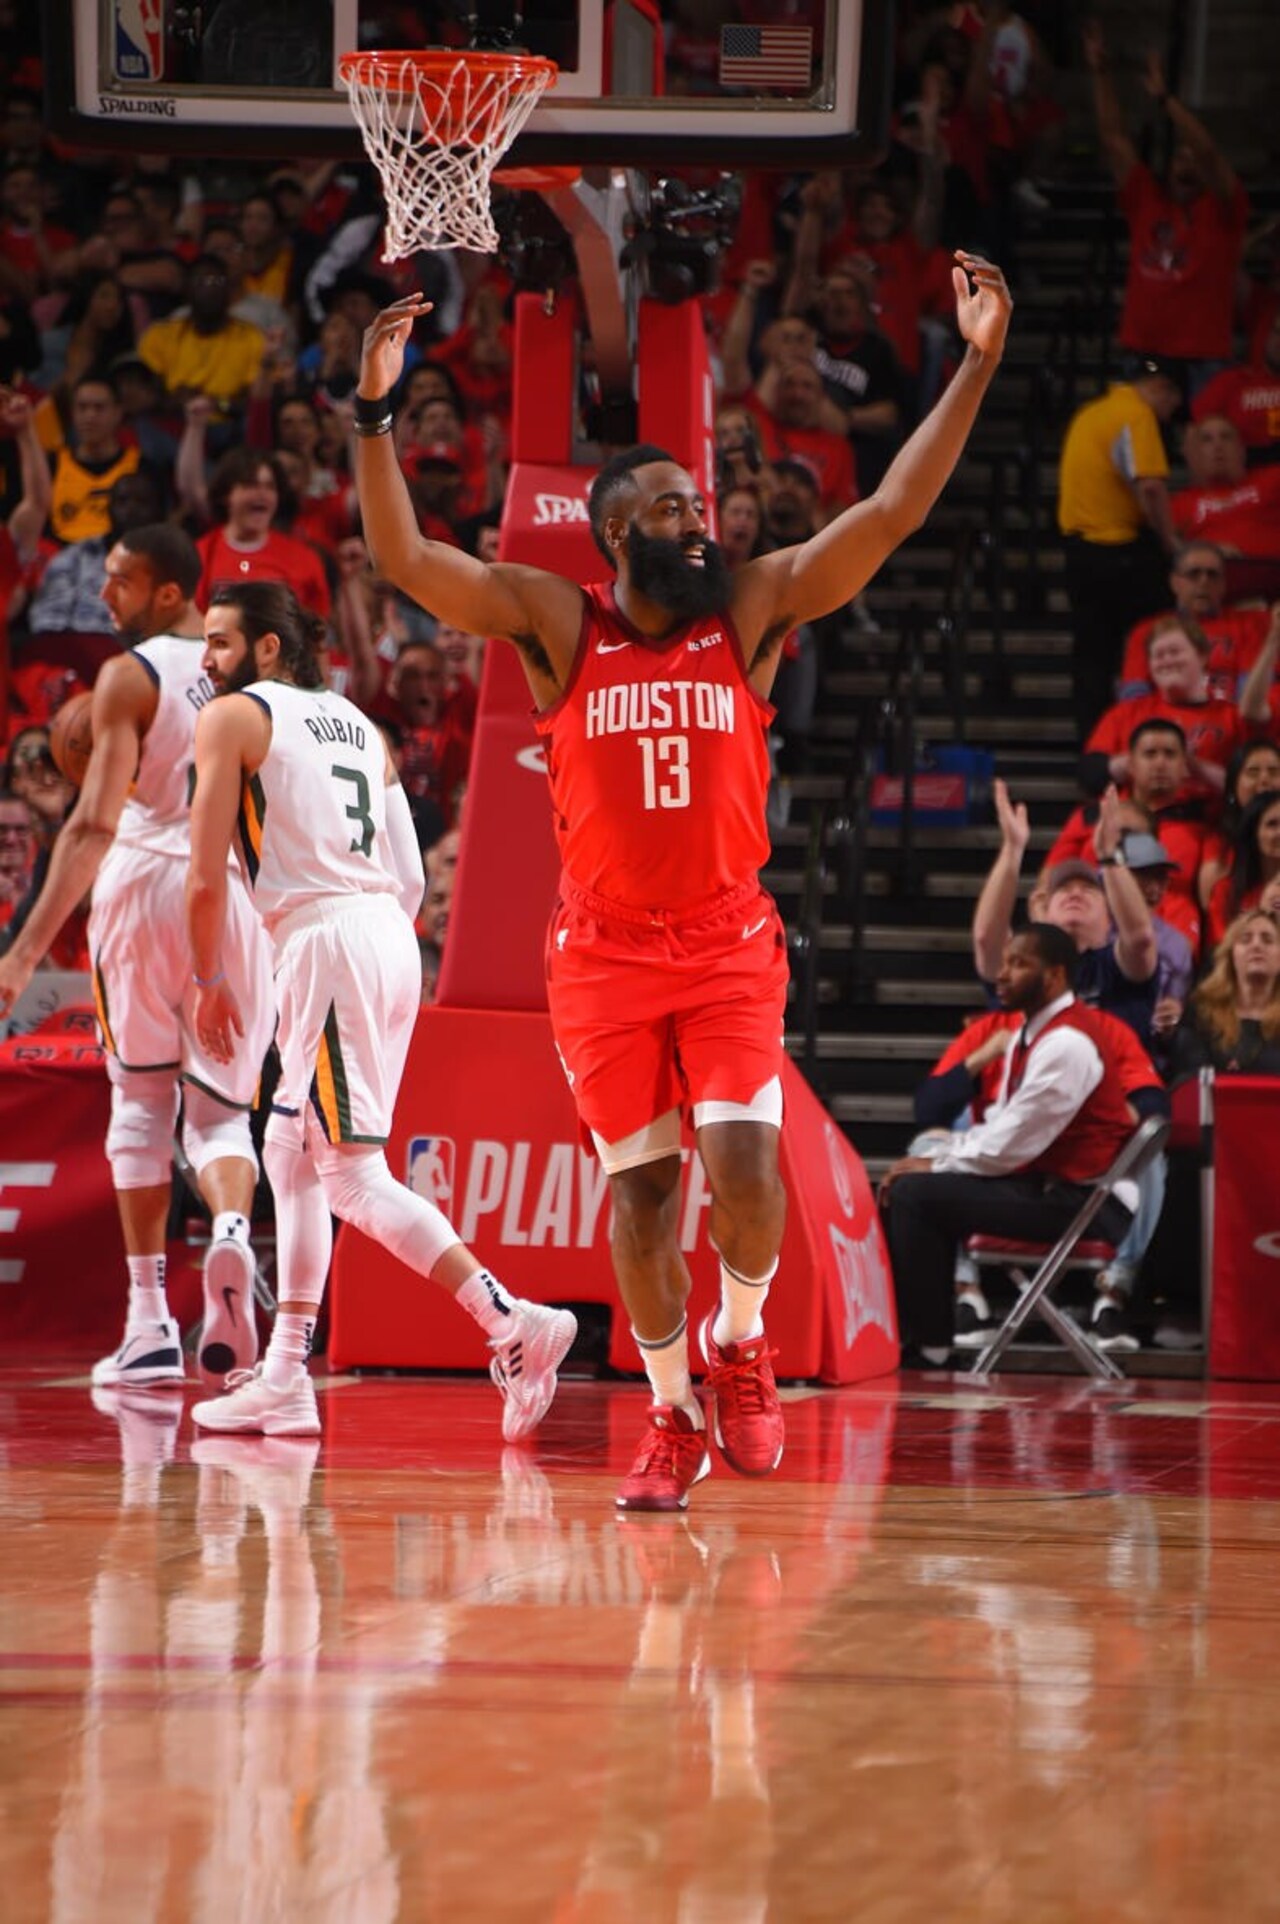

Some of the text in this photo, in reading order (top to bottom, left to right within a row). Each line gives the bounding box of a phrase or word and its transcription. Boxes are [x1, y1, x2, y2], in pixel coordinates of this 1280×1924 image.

[98, 97, 176, 117] SPALDING
[304, 716, 366, 751] RUBIO
[586, 681, 735, 739] HOUSTON
[637, 735, 691, 810] 13
[331, 764, 376, 858] 3
